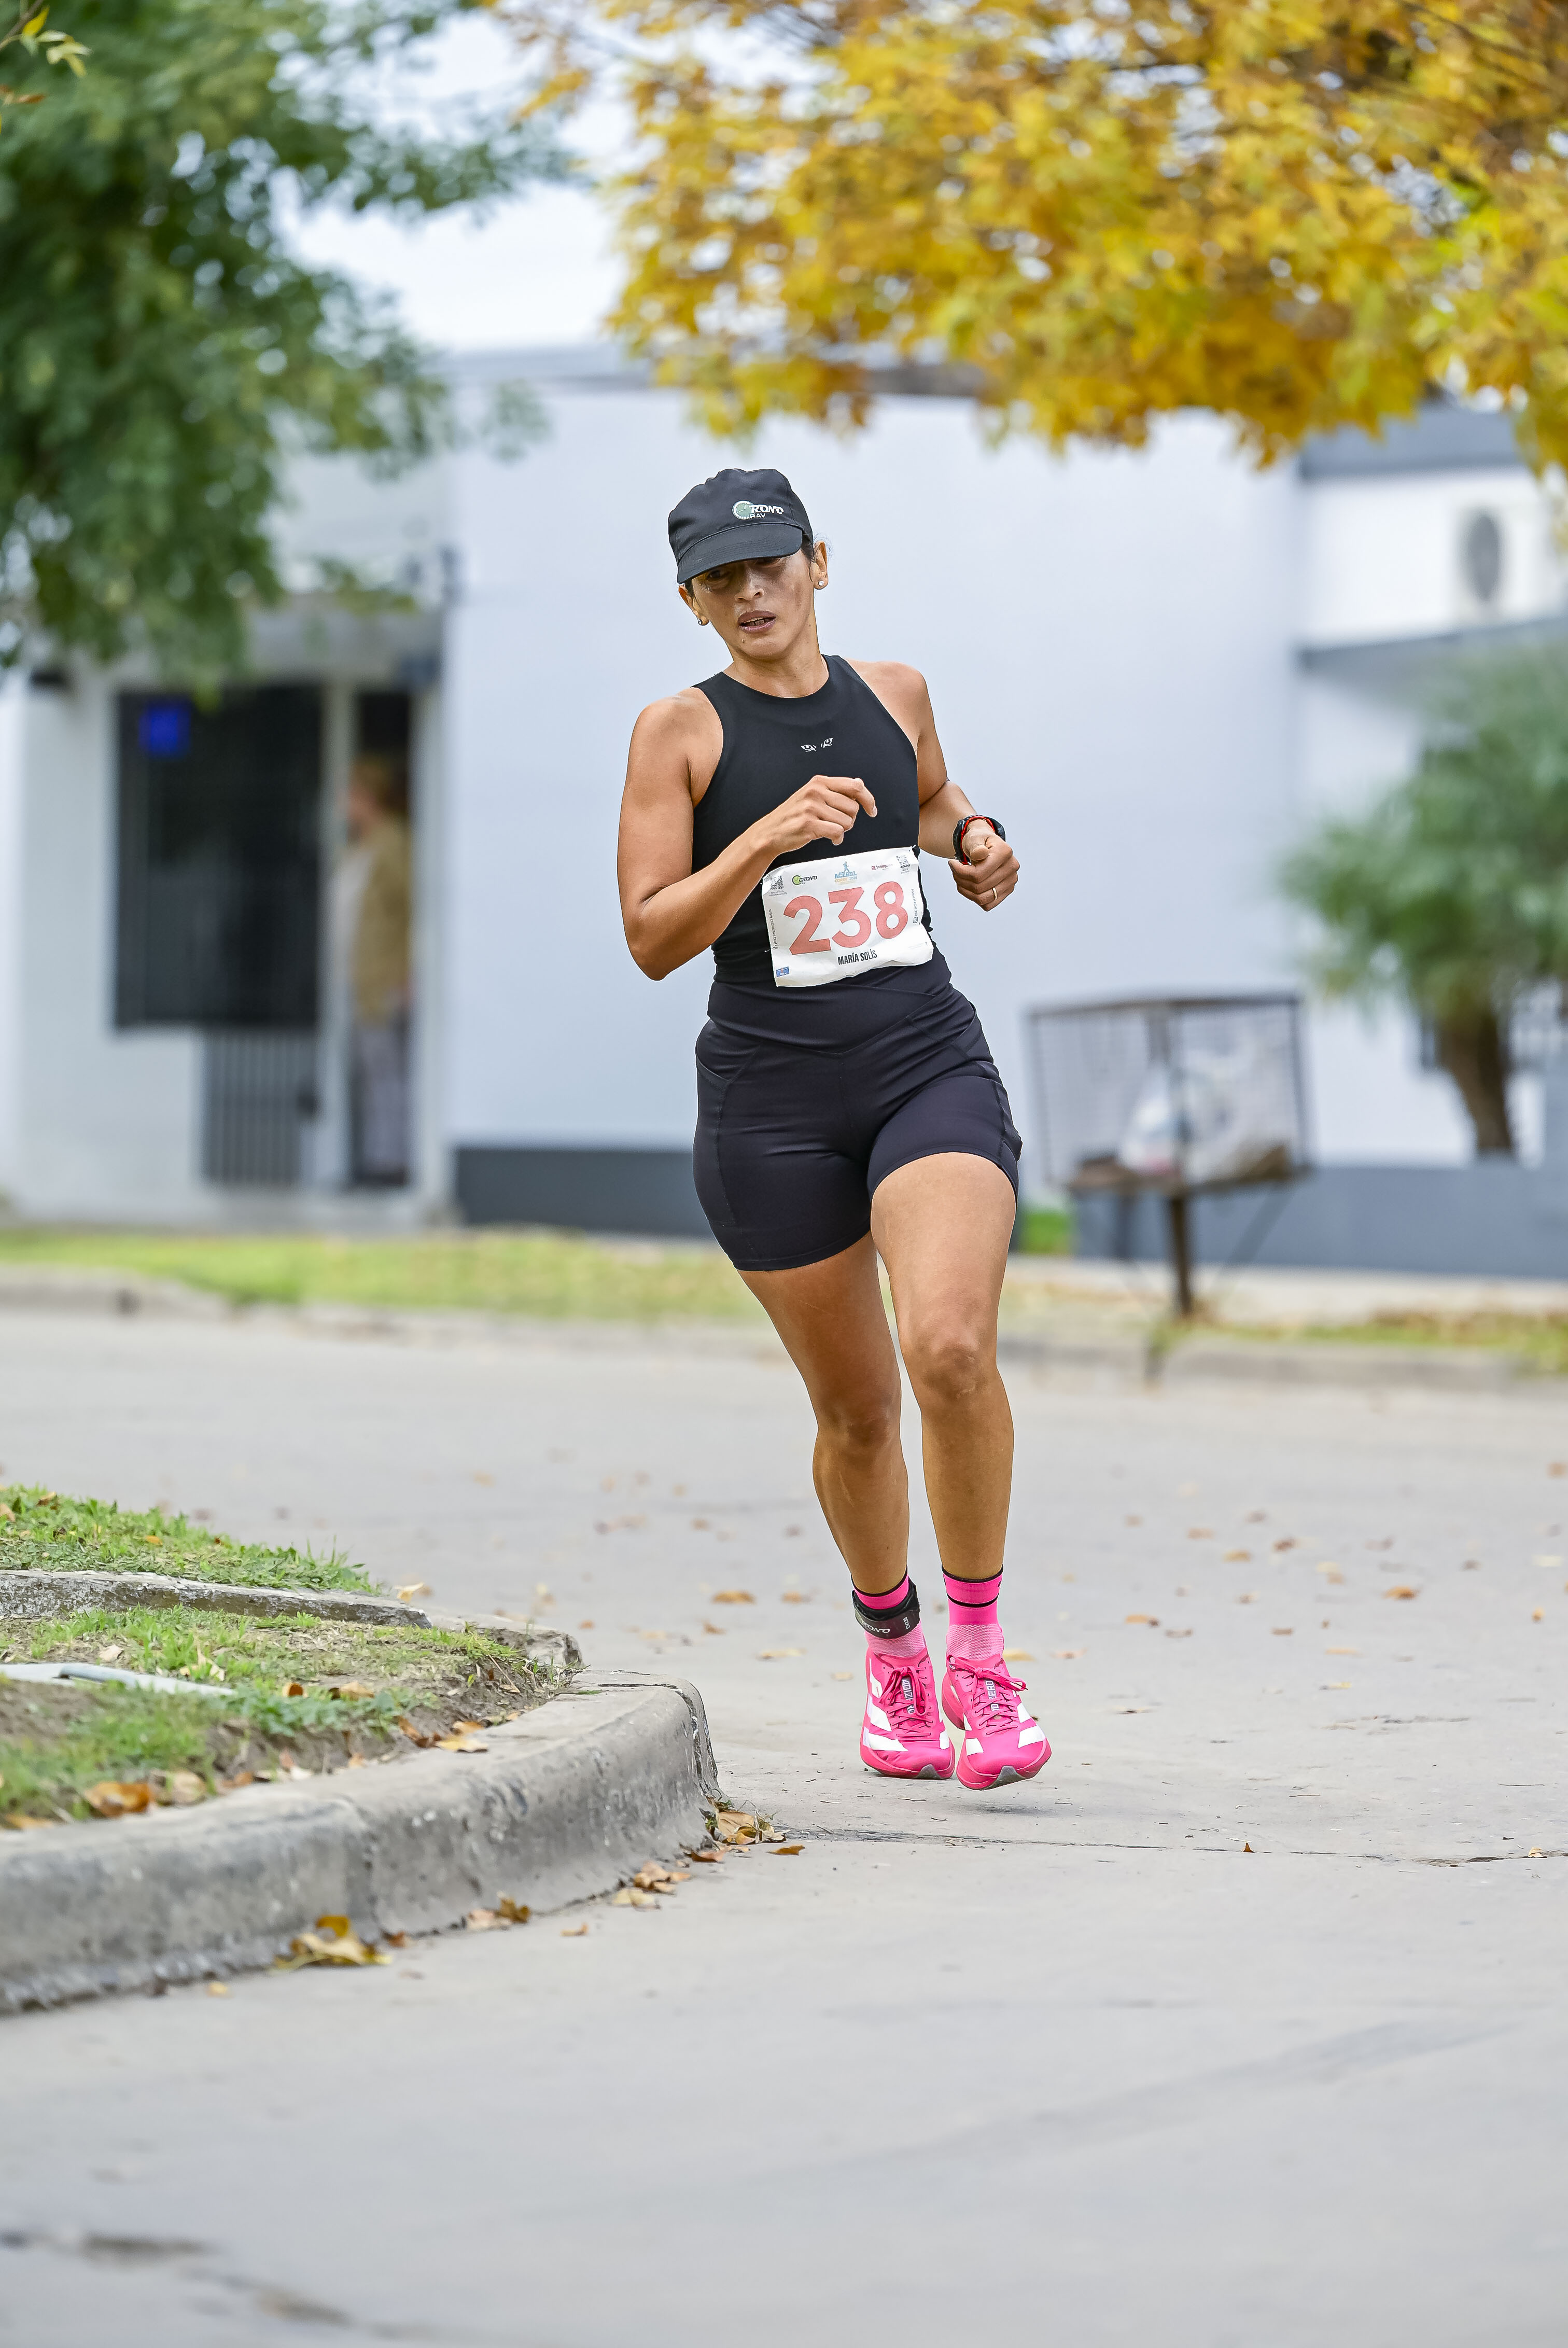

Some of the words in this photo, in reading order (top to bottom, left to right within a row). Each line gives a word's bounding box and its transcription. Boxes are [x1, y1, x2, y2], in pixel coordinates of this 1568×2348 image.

[834, 871, 857, 879] ACEBAL
[783, 881, 908, 955] 238
[837, 952, 859, 965] MARÍA
[860, 948, 877, 961] SOLÍS
